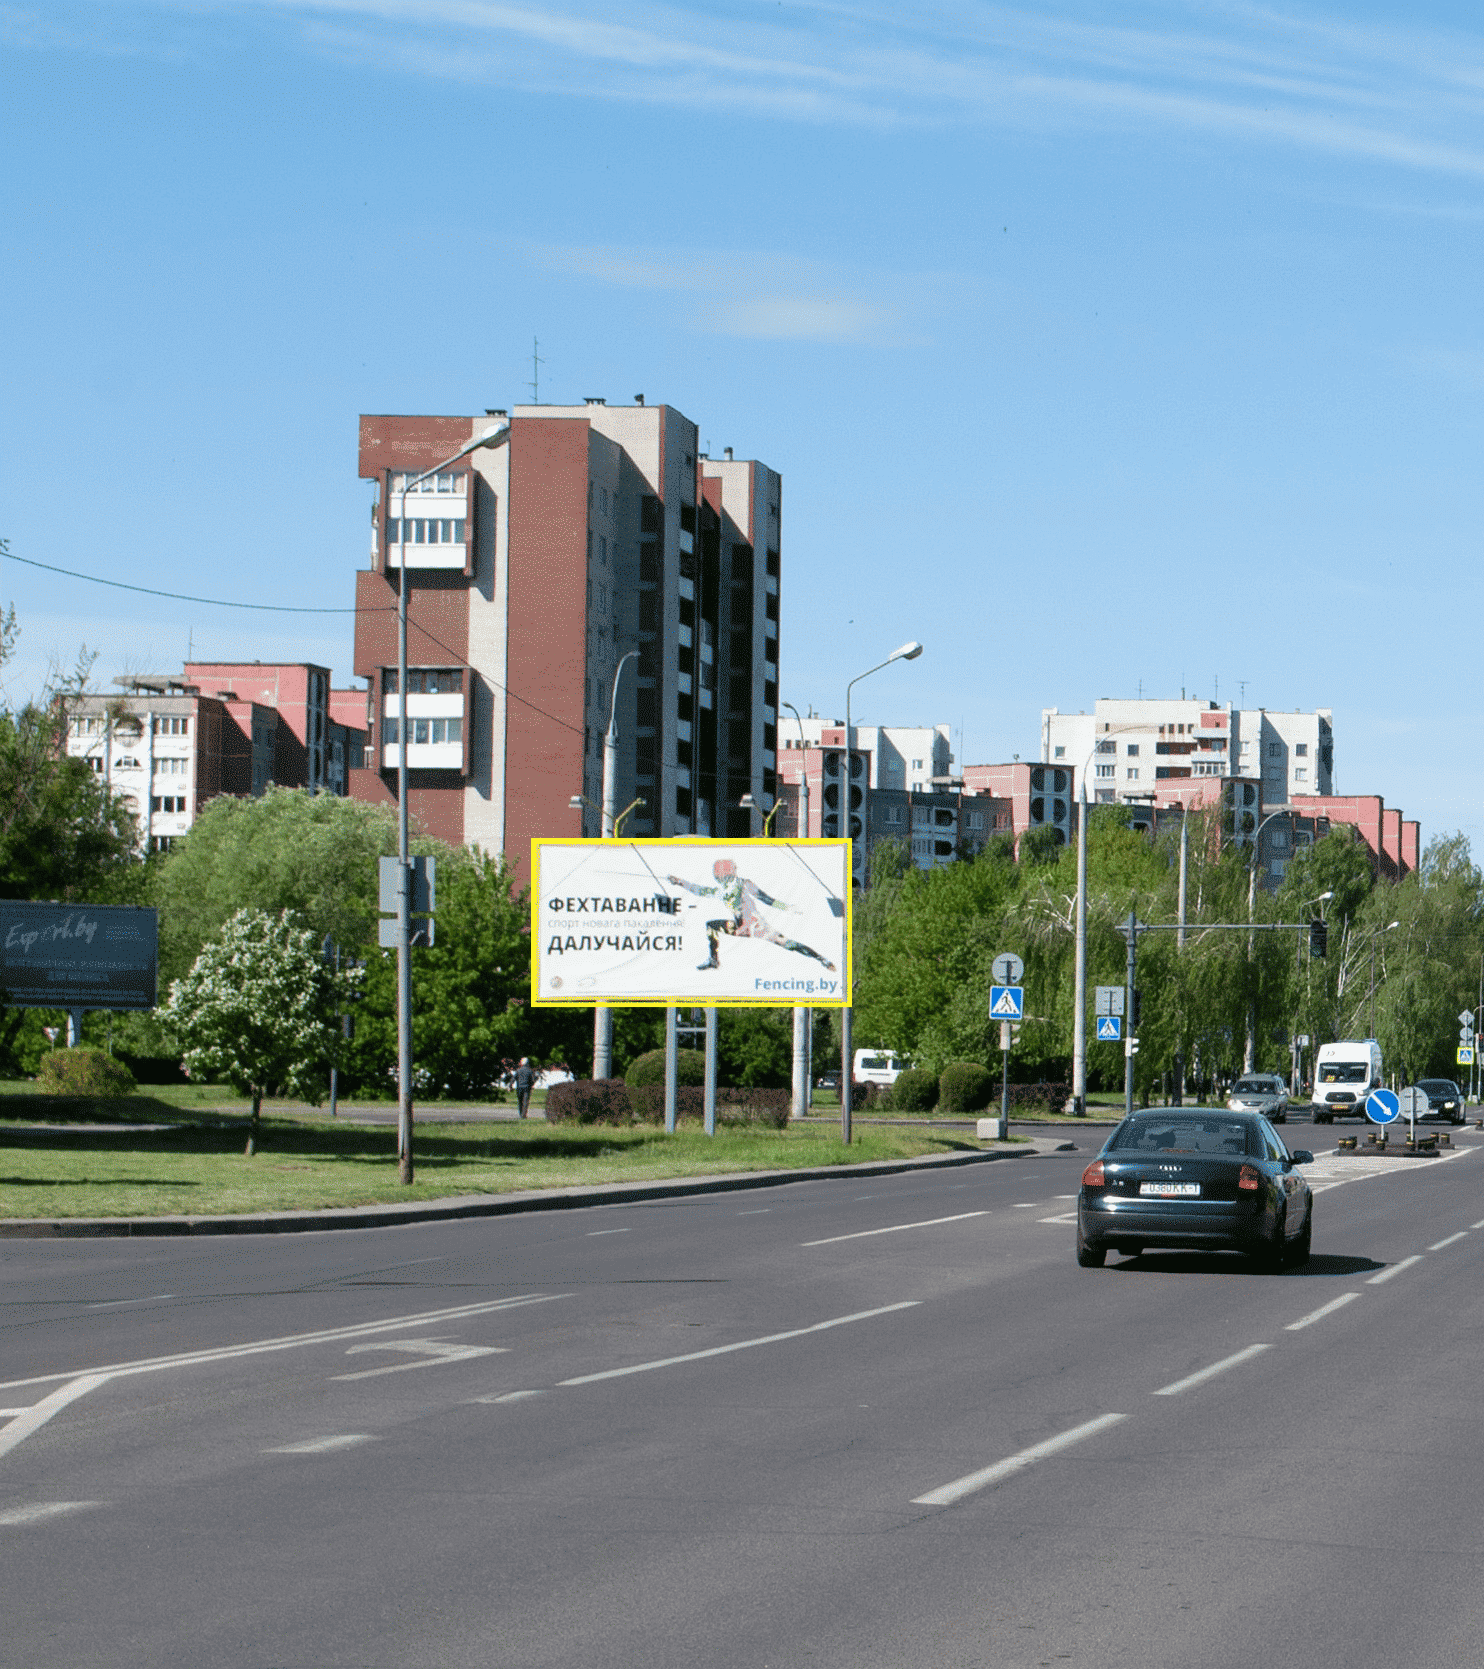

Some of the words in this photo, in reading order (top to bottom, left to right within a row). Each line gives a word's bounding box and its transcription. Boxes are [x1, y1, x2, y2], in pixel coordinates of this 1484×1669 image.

[548, 919, 579, 930] спорт
[582, 919, 620, 928] новага
[548, 931, 683, 954] ДАЛУЧАЙСЯ!
[754, 978, 838, 993] Fencing.by
